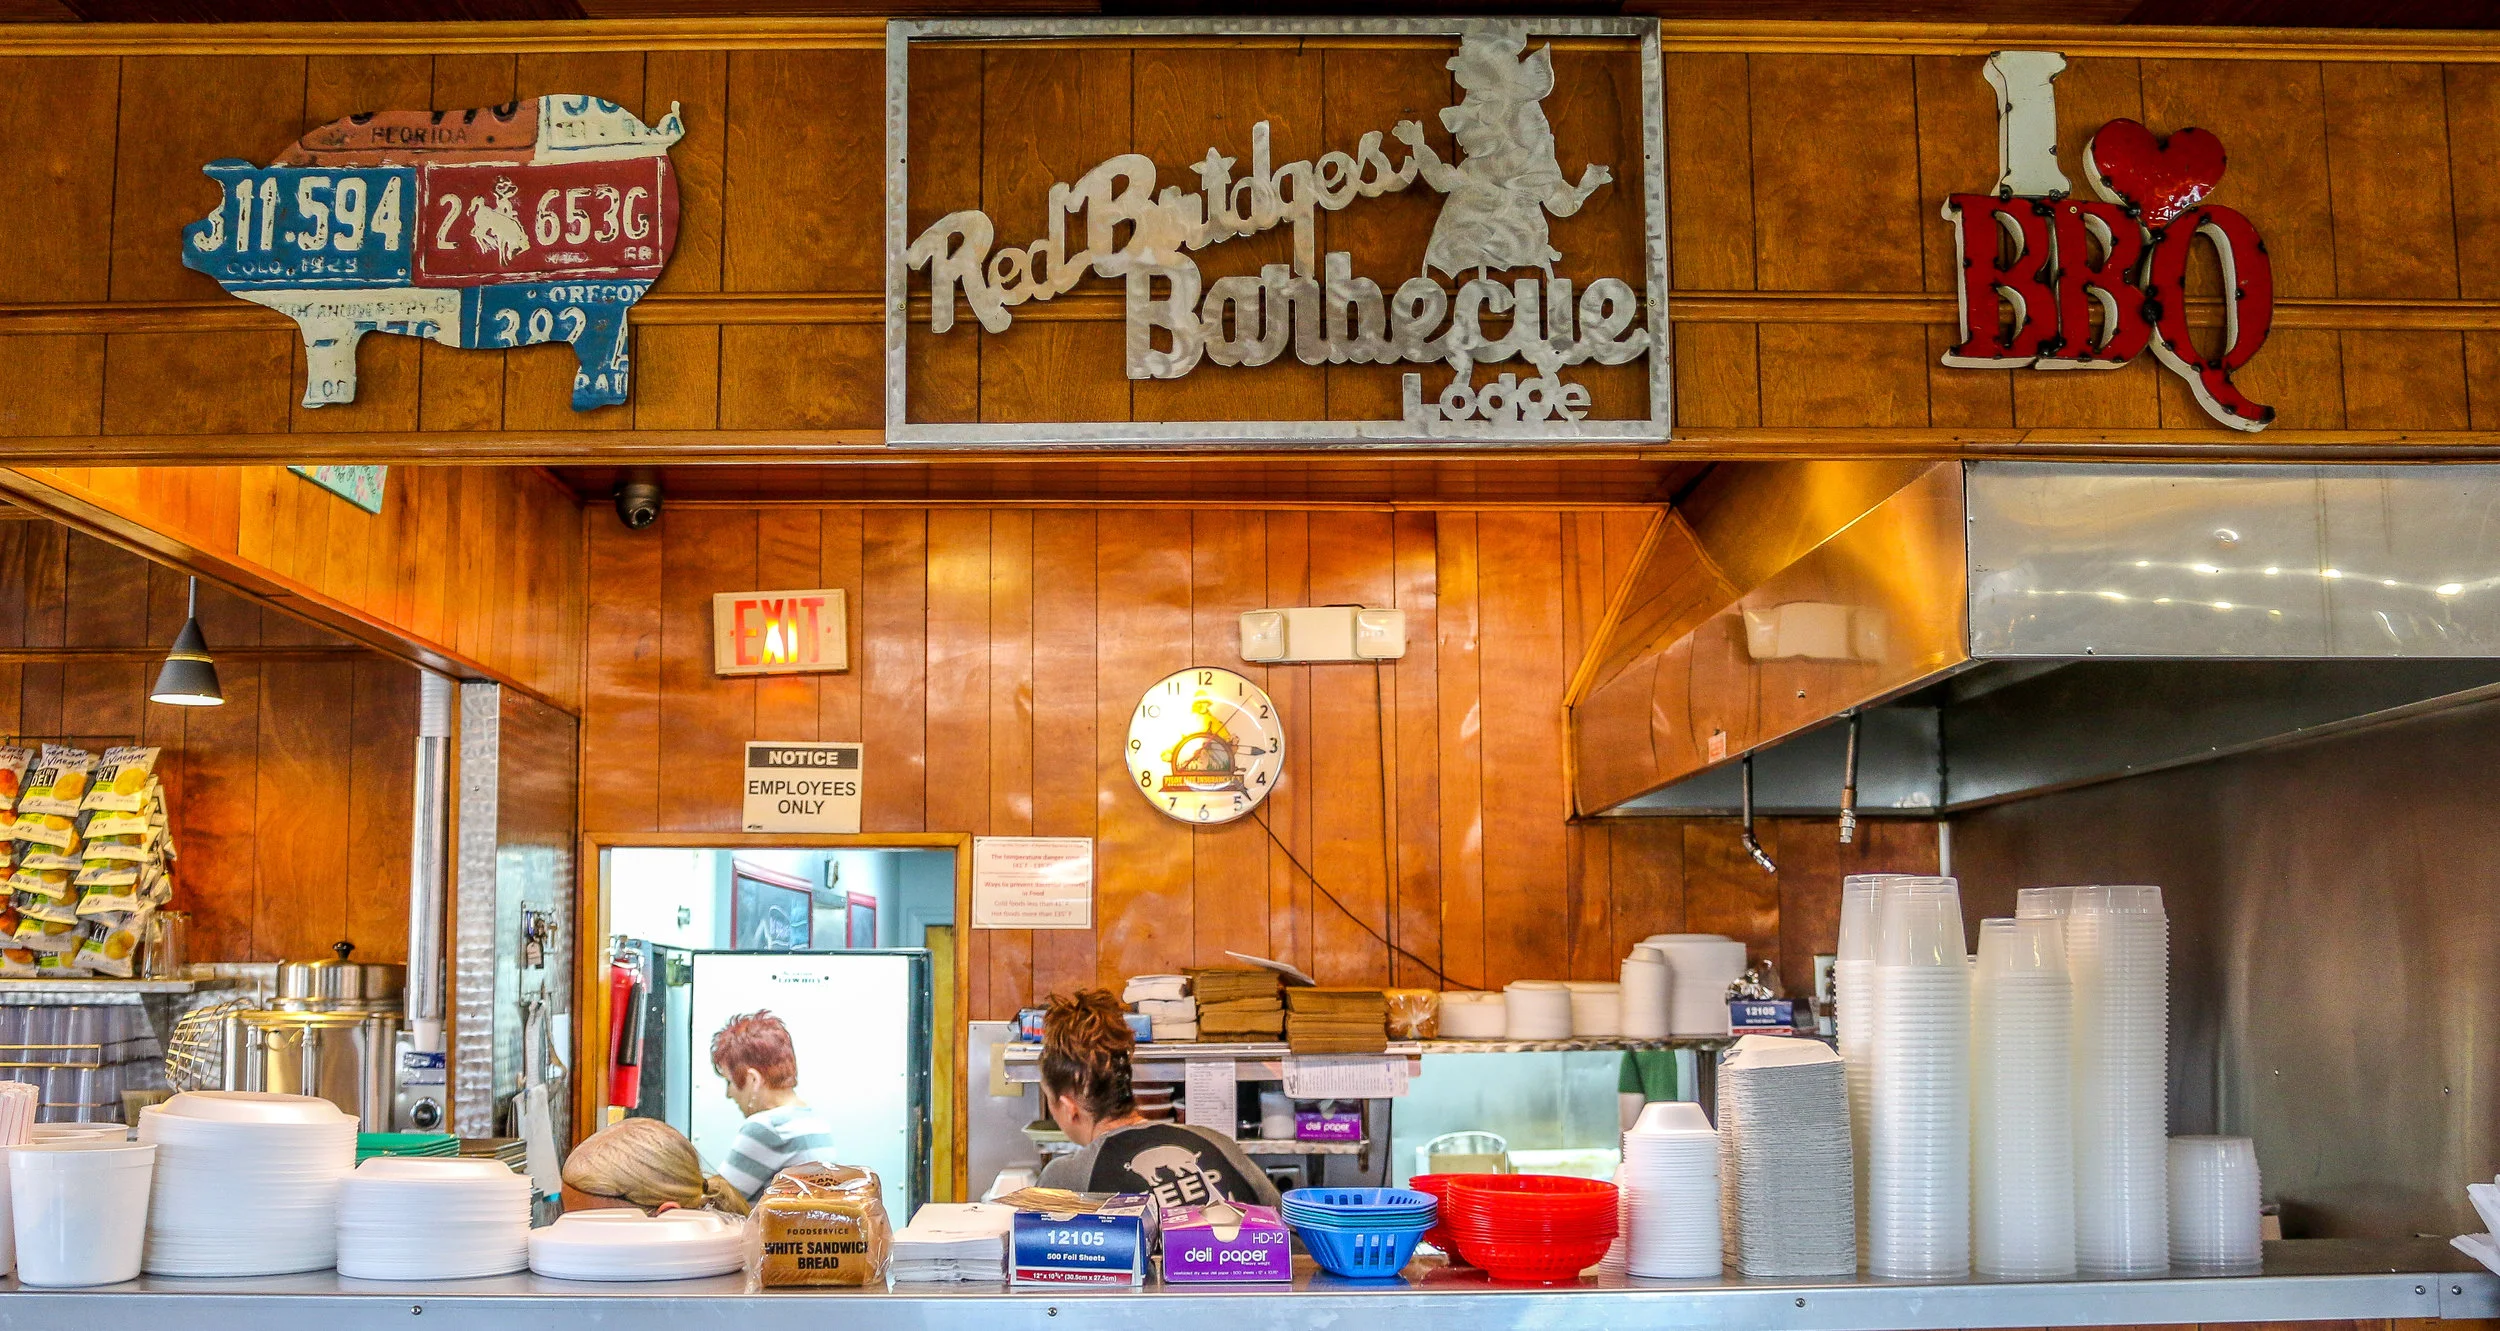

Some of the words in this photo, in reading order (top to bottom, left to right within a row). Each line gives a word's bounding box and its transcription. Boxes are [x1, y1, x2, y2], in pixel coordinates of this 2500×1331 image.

[1983, 50, 2071, 197] I
[371, 126, 467, 145] FLORIDA
[436, 193, 462, 250] 2
[535, 186, 649, 246] 653G
[907, 181, 1096, 335] Red
[1126, 252, 1652, 380] Barbecue
[1942, 193, 2276, 432] BBQ
[1401, 372, 1592, 422] Lodge
[733, 596, 826, 667] EXIT
[1198, 671, 1213, 686] 12
[1167, 682, 1180, 696] 11
[1142, 704, 1160, 718] 10
[1260, 705, 1268, 719] 2
[1131, 739, 1141, 754] 9
[1269, 738, 1278, 754] 3
[768, 750, 838, 765] NOTICE
[1141, 770, 1152, 788] 8
[1256, 771, 1266, 786] 4
[748, 780, 856, 796] EMPLOYEES
[777, 799, 825, 815] ONLY
[1169, 796, 1177, 811] 7
[1234, 795, 1243, 811] 5
[1199, 804, 1209, 821] 6
[1323, 1122, 1350, 1132] paper
[1047, 1229, 1105, 1246] 12105
[1252, 1232, 1284, 1244] HD-12
[764, 1241, 803, 1255] WHITE
[1184, 1247, 1212, 1263] deli
[1219, 1249, 1268, 1265] paper
[797, 1257, 839, 1270] BREAD
[1078, 1254, 1105, 1262] Sheets
